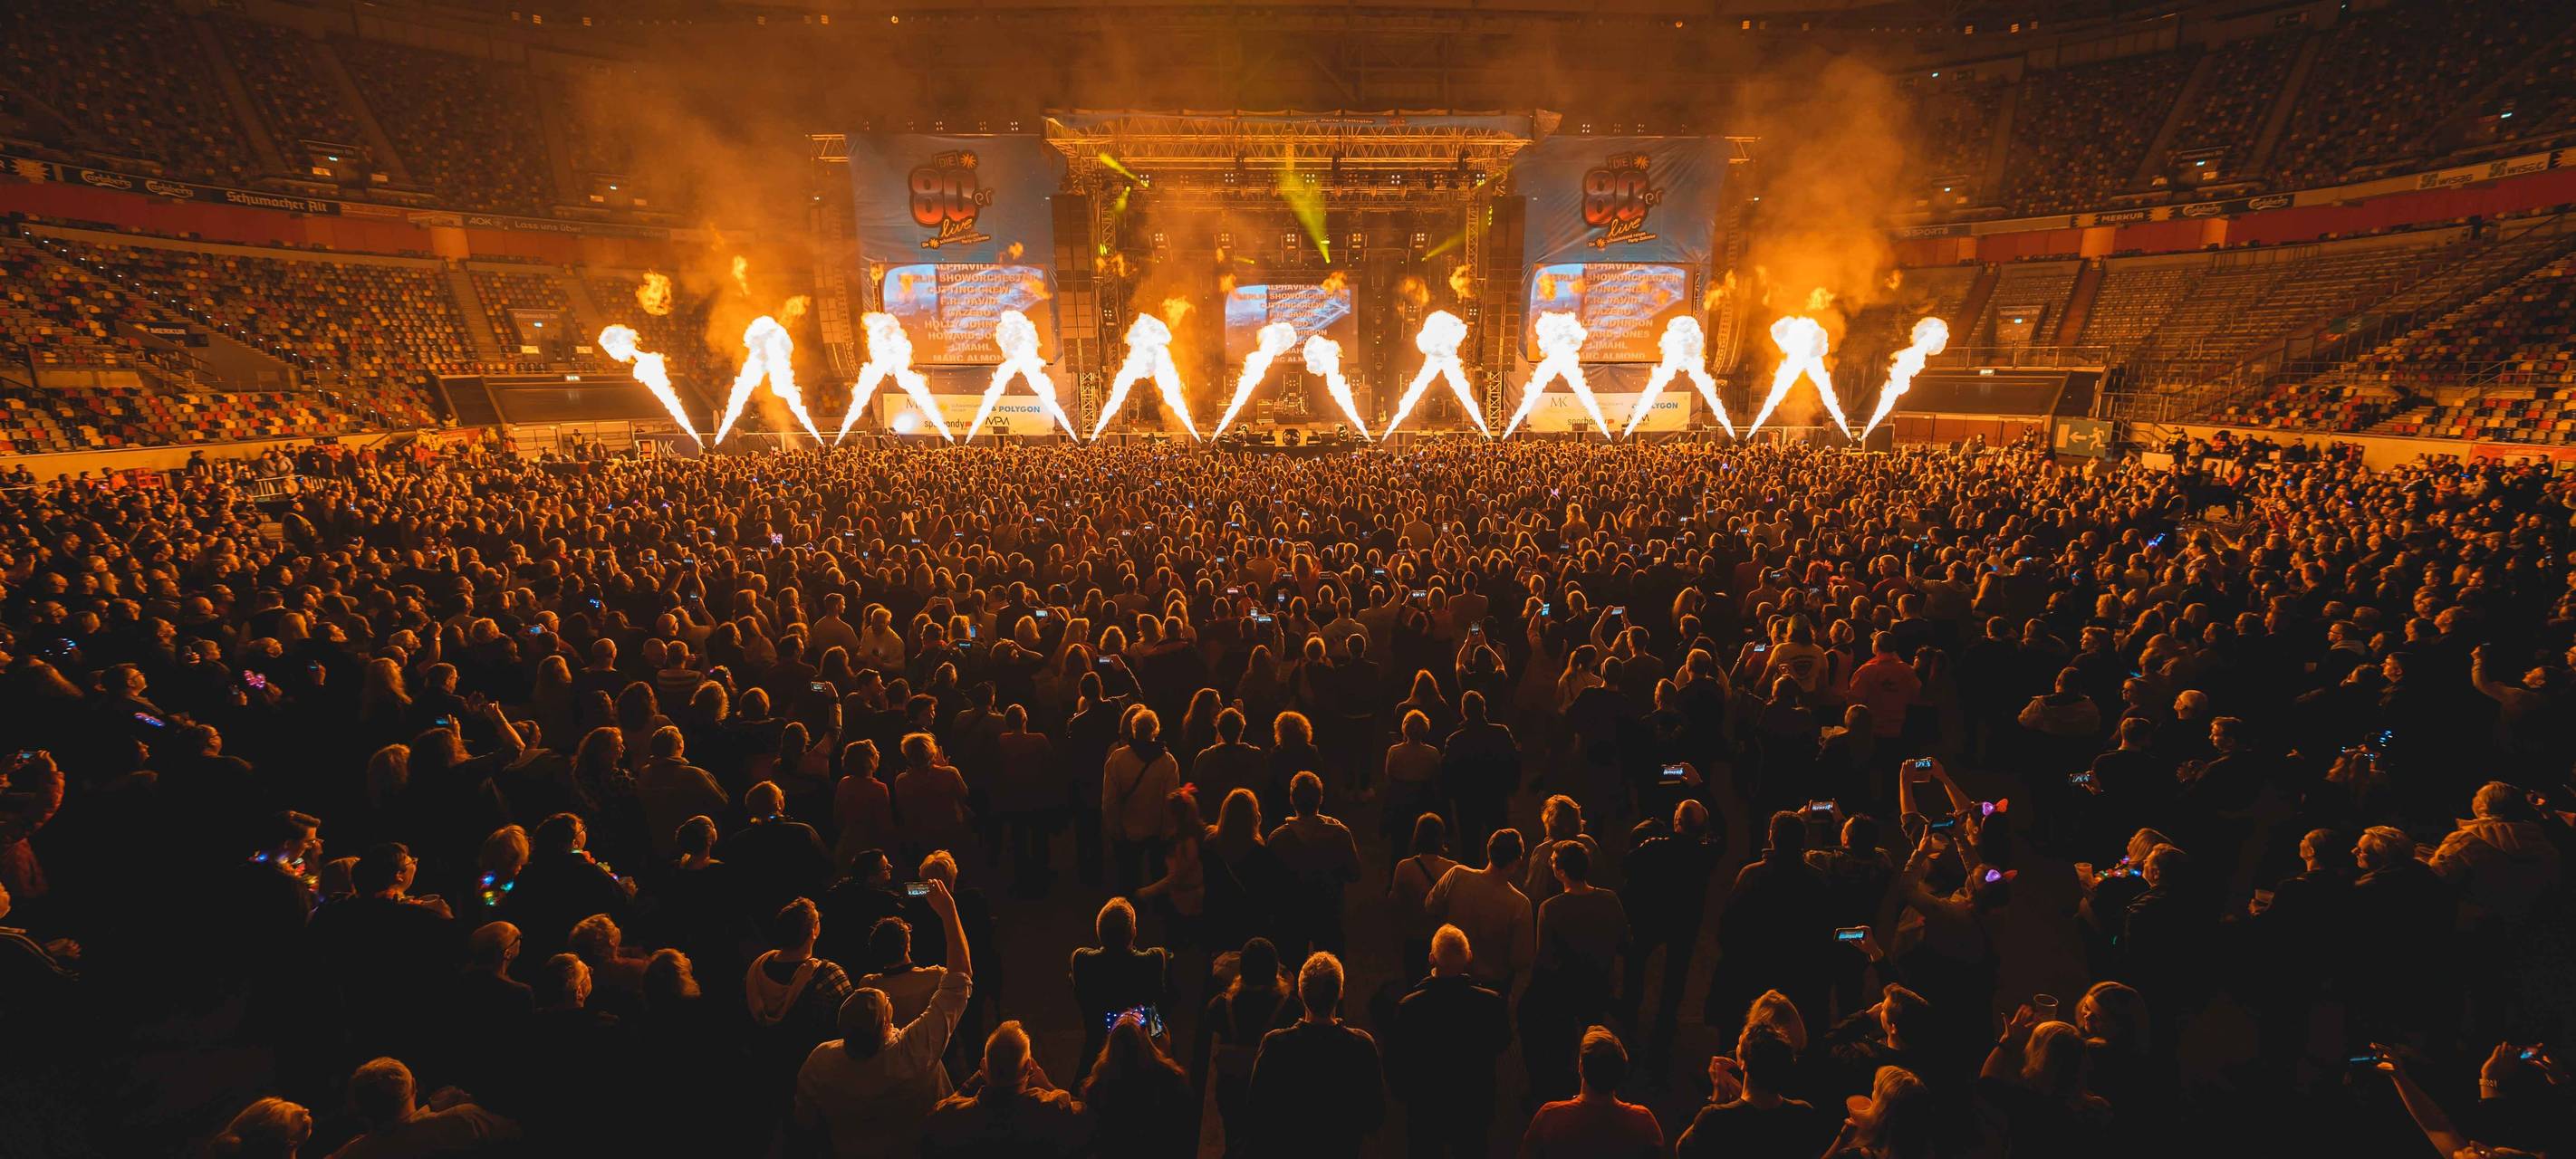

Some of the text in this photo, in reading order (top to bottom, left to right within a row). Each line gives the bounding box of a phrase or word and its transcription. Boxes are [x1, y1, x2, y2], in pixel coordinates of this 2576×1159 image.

[938, 157, 955, 168] DIE
[1612, 158, 1629, 168] DIE
[81, 169, 194, 198] Carlsberg Carlsberg
[226, 190, 305, 210] Schumacher
[306, 200, 327, 213] Alt
[2247, 196, 2289, 210] Carlsberg
[2182, 204, 2222, 217] Carlsberg
[468, 216, 493, 225] AOK
[2100, 212, 2144, 223] MERKUR
[514, 220, 538, 230] Lass
[540, 223, 558, 231] uns
[940, 217, 973, 237] live
[1608, 217, 1641, 237] live
[1607, 319, 1653, 327] JOHNSON
[1615, 330, 1650, 339] JONES
[932, 354, 1005, 362] MARC ALMON
